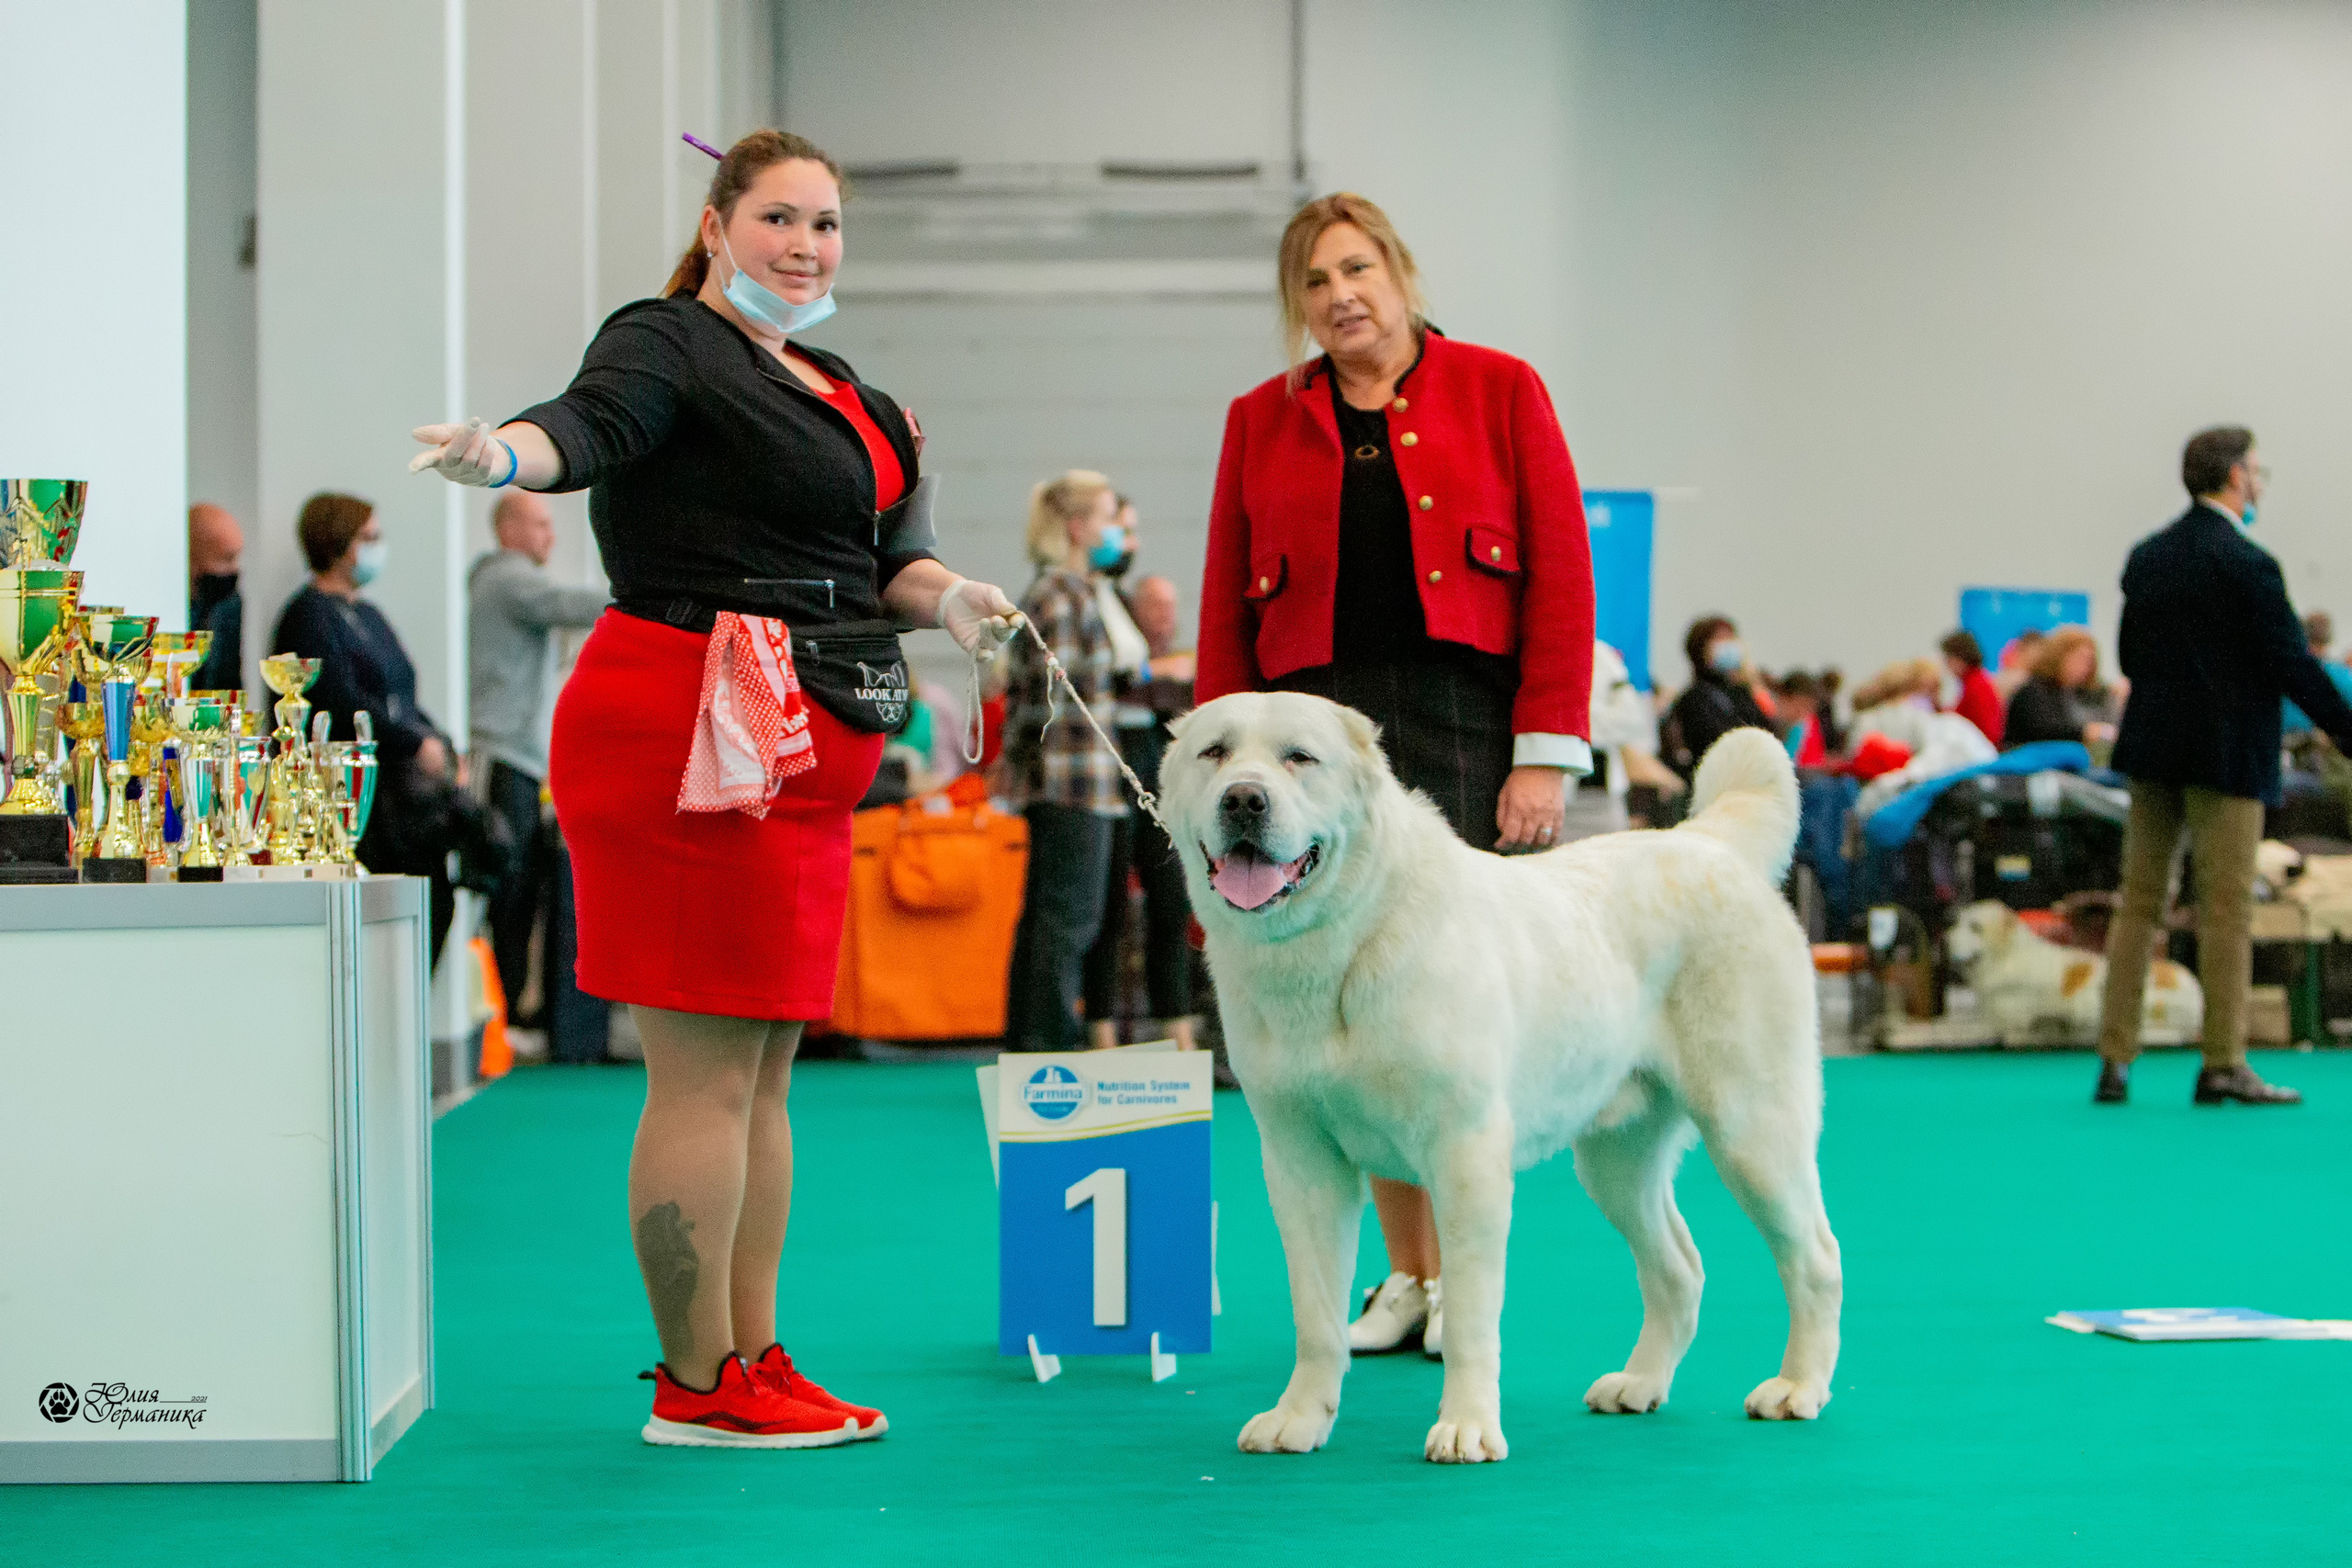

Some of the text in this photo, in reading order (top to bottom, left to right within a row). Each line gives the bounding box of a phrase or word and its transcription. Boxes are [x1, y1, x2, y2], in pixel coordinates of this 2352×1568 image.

[854, 687, 891, 701] LOOK
[892, 688, 901, 701] AT
[1023, 1085, 1083, 1100] Farmina
[1097, 1079, 1191, 1093] Nutrition System
[1097, 1093, 1178, 1105] for Carnivores
[1065, 1168, 1126, 1326] 1
